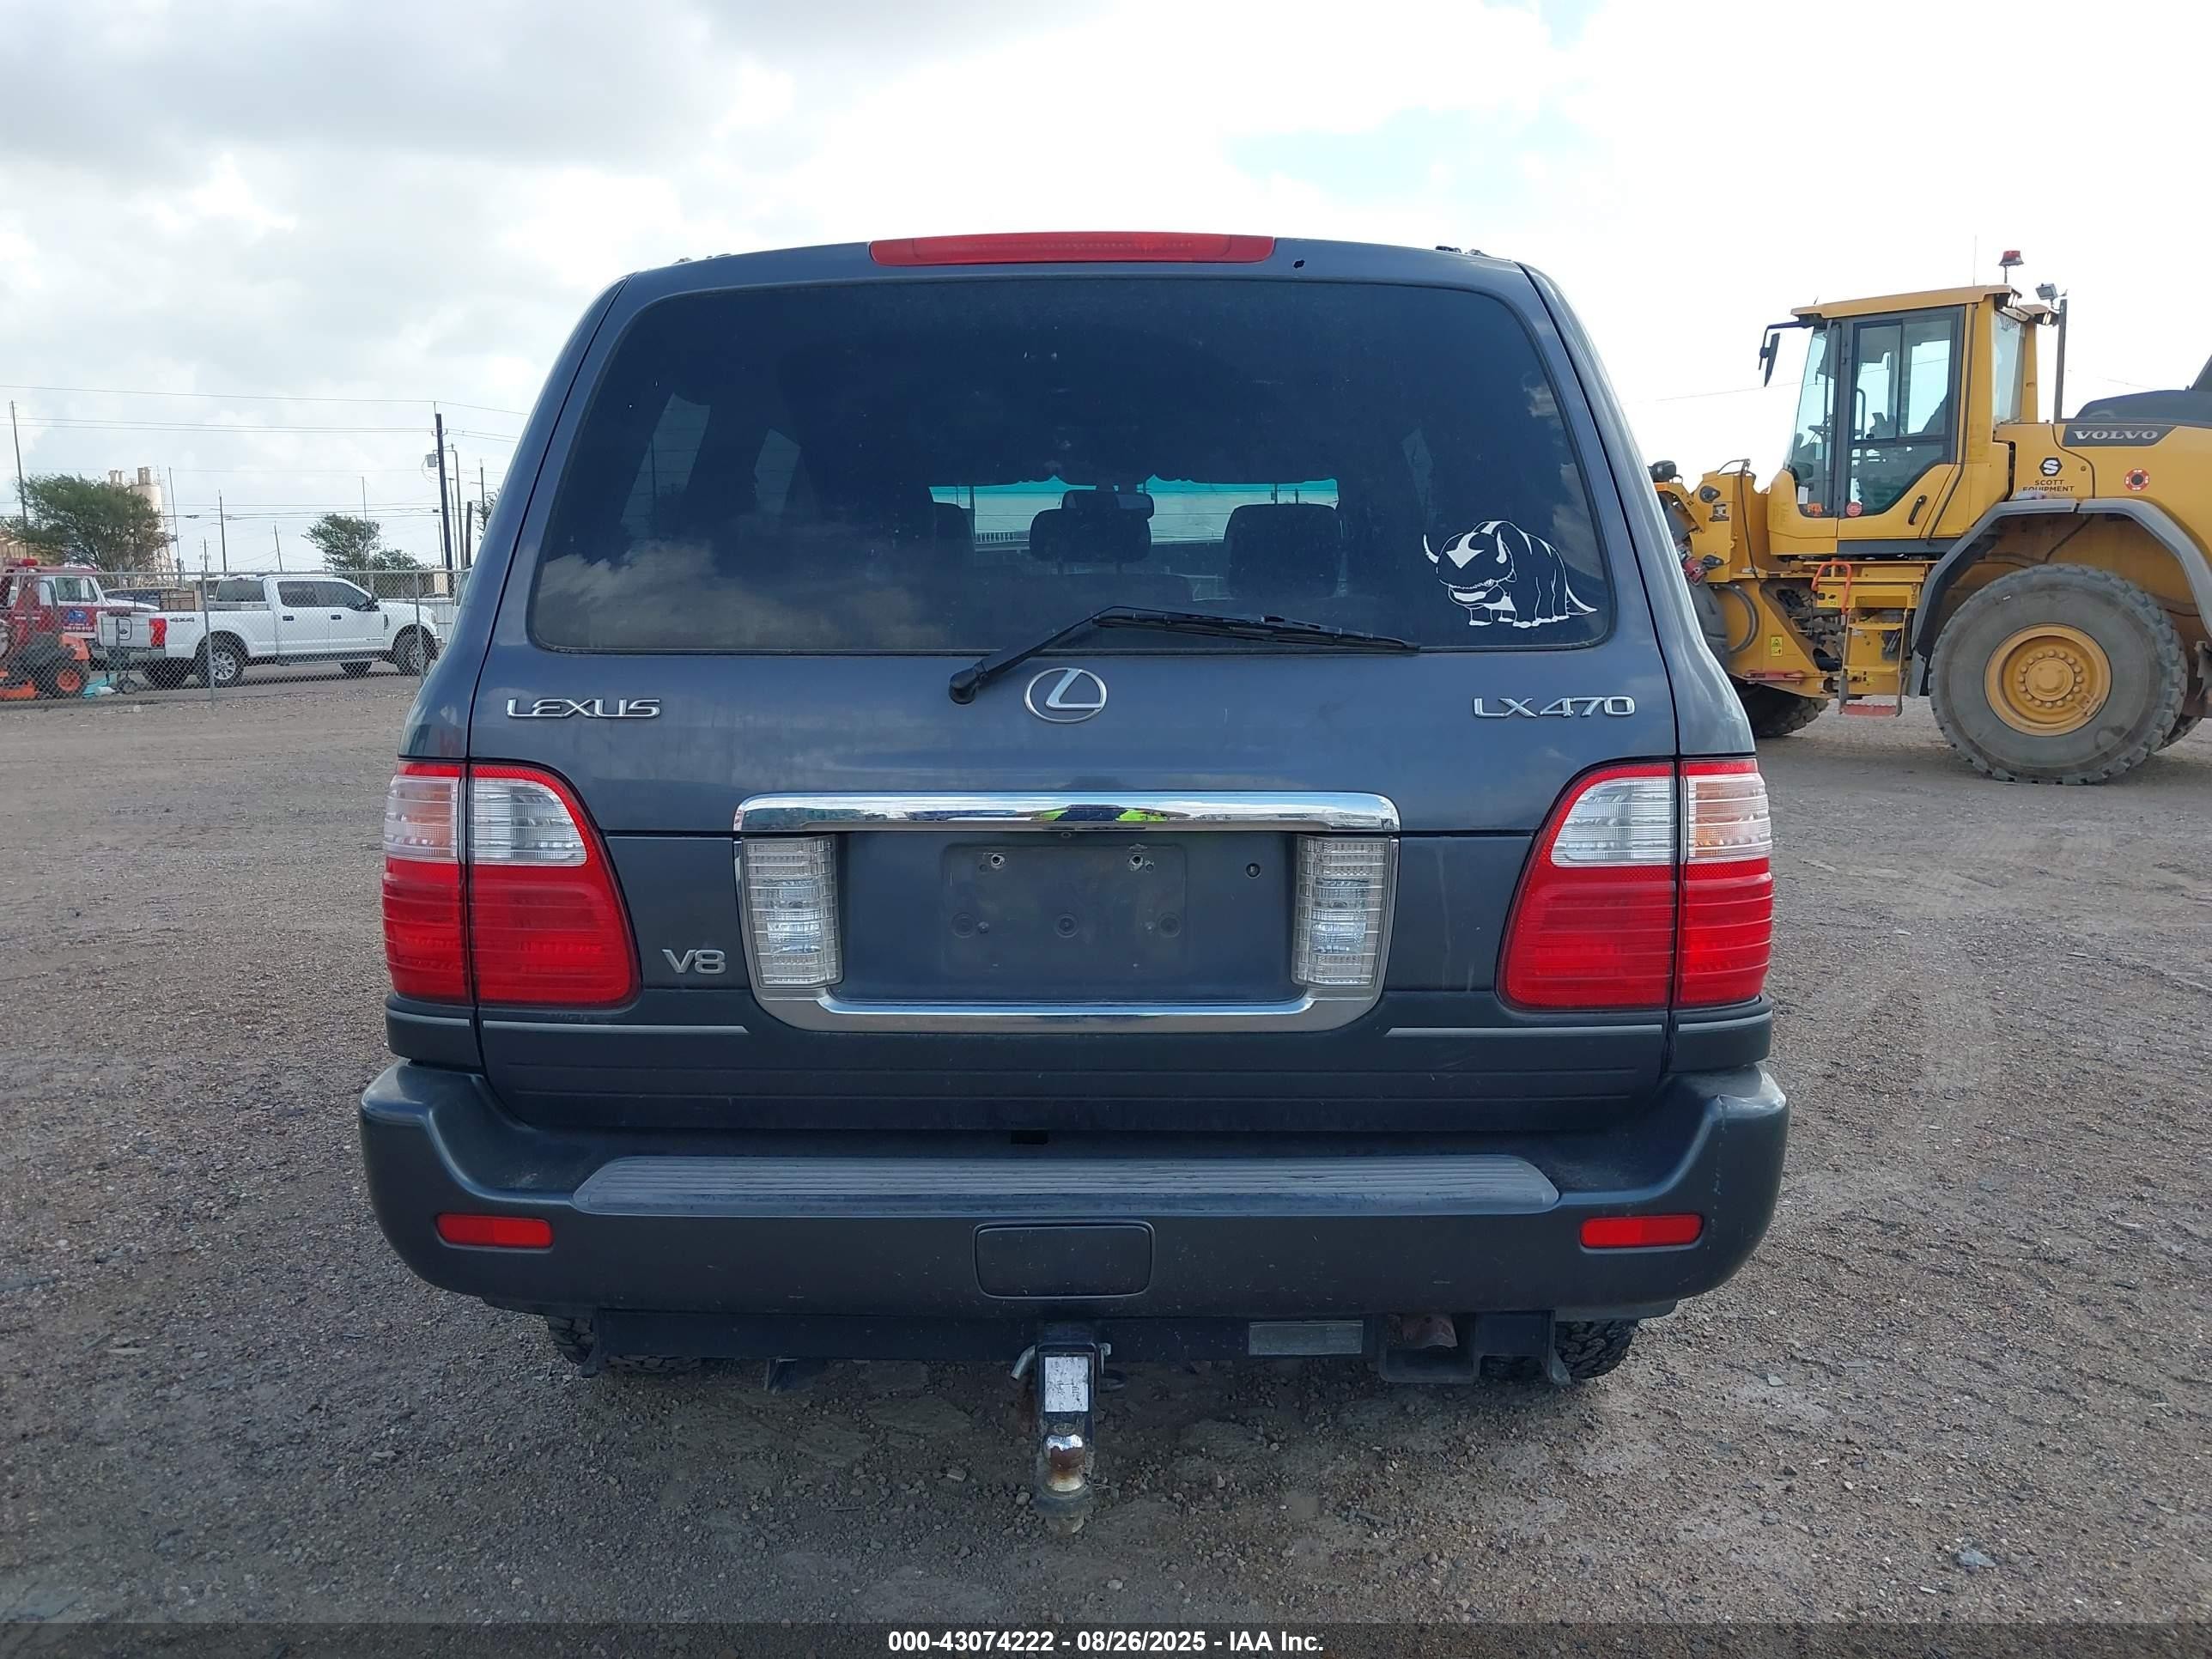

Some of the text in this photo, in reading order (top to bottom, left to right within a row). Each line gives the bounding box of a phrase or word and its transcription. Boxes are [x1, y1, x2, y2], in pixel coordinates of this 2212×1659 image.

[2074, 430, 2158, 440] VOLVO
[507, 698, 660, 718] LEXUS
[661, 949, 726, 975] V8
